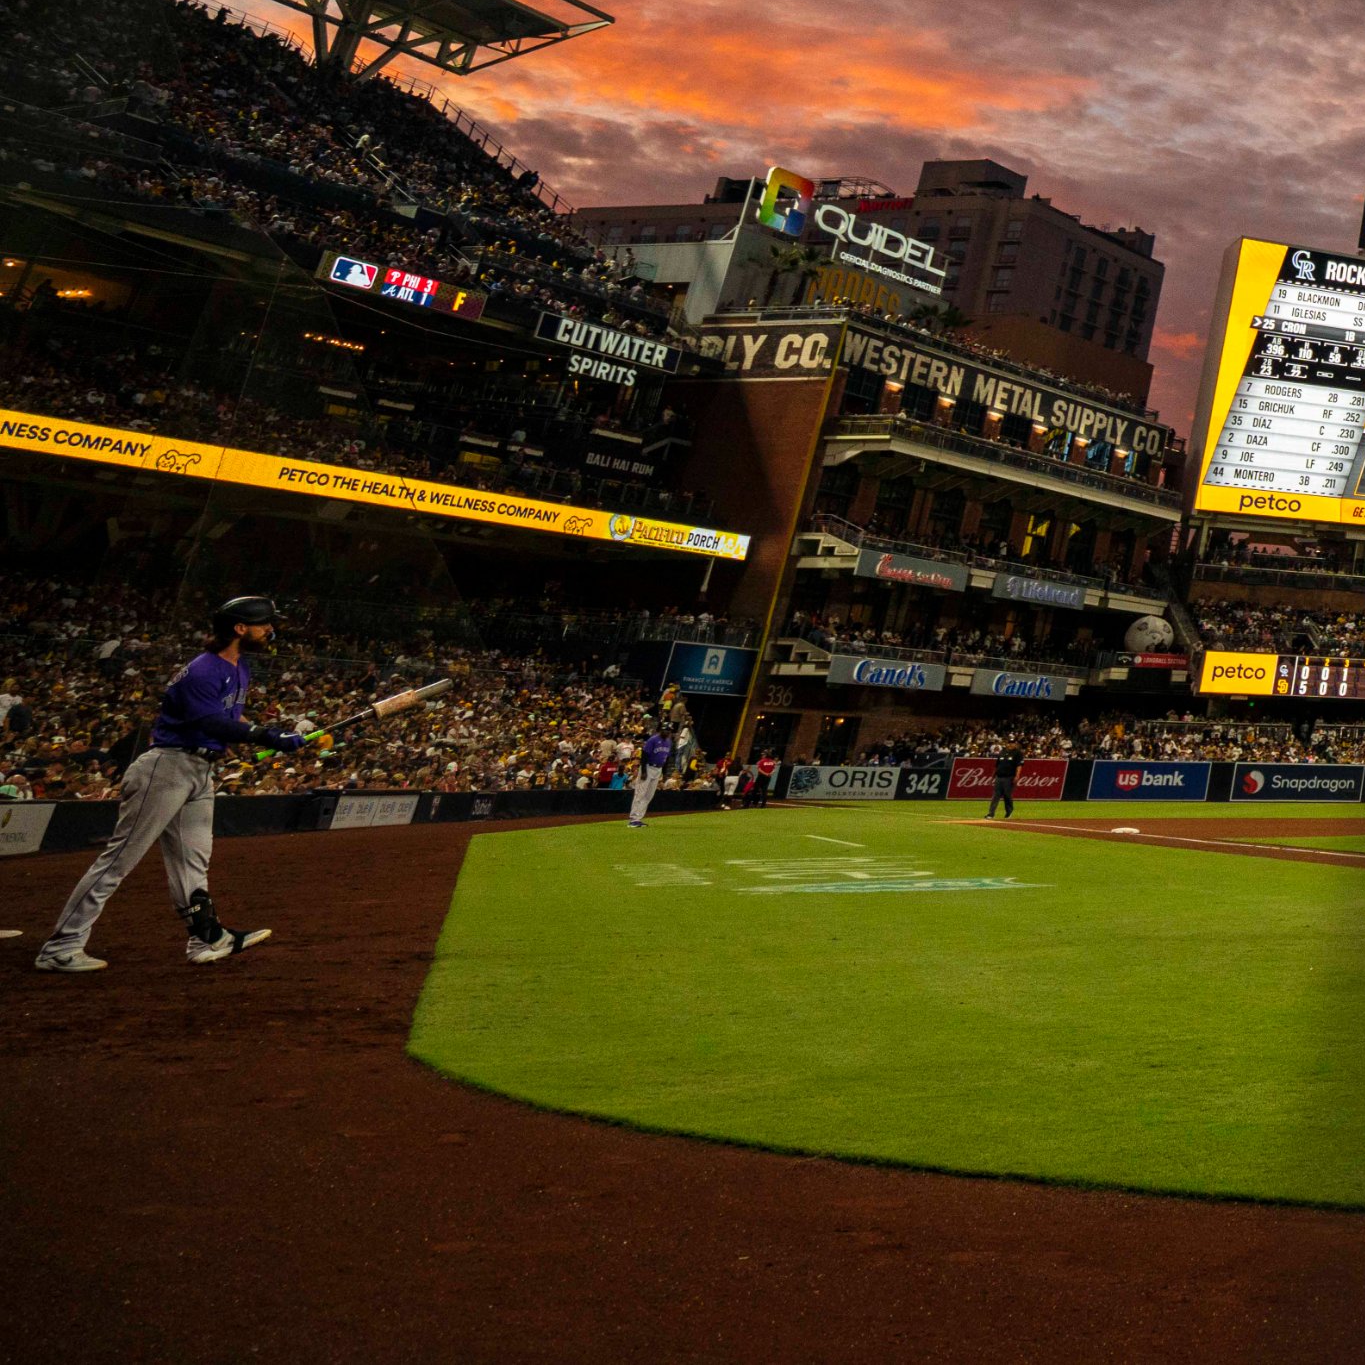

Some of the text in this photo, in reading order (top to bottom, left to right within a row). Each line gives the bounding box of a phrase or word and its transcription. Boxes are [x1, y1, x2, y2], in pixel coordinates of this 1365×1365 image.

[814, 204, 946, 277] QUIDEL
[402, 274, 422, 289] PHI
[840, 251, 942, 295] OFFICIAL DIAGNOSTICS PARTNER
[396, 287, 414, 302] ATL
[1297, 291, 1341, 307] BLACKMON
[1291, 307, 1327, 321] IGLESIAS
[1281, 320, 1307, 335] CRON
[555, 318, 669, 369] CUTWATER
[773, 332, 833, 370] CO.
[1266, 343, 1285, 355] 396
[568, 354, 638, 388] SPIRITS
[841, 331, 1164, 456] WESTERN METAL SUPPLY CO.
[1264, 384, 1365, 407] RODGERS .281
[1258, 401, 1361, 423] GRICHUK .252
[1252, 416, 1355, 439] DÍAZ .230
[53, 430, 151, 458] COMPANY
[1246, 434, 1350, 456] DAZA .300
[585, 452, 654, 477] BALI HAI RUM
[1240, 451, 1344, 472] JOE .249
[1233, 468, 1275, 483] MONTERO
[278, 466, 561, 524] PETCO THE HEALTH & WELLNESS COMPANY
[1239, 494, 1302, 512] petco
[686, 533, 720, 550] PORCH
[853, 660, 926, 688] Canel's
[1211, 664, 1266, 682] petco
[763, 684, 793, 707] 336
[992, 672, 1052, 698] Canel's
[828, 770, 894, 789] ORIS
[905, 774, 941, 794] 342
[1117, 771, 1183, 786] us bank
[1271, 774, 1355, 792] Snapdragon
